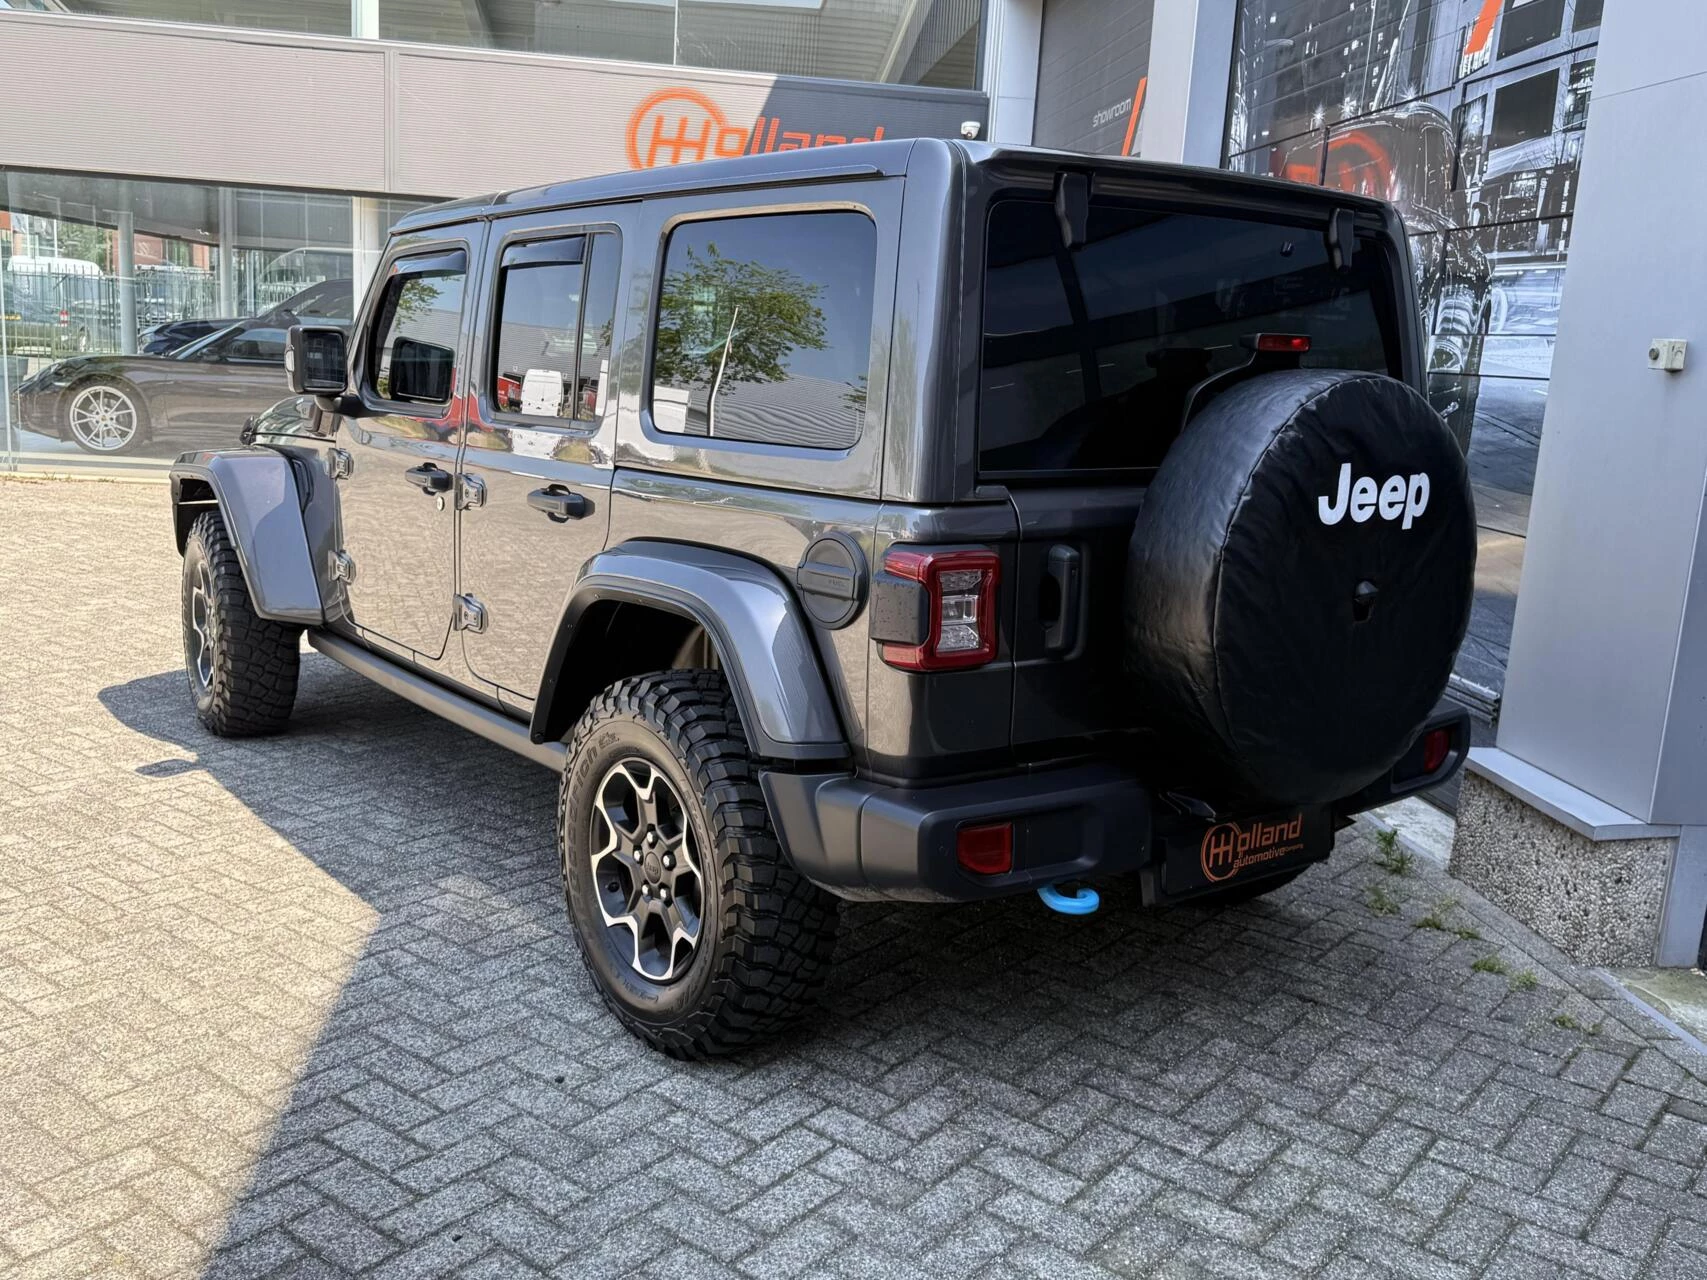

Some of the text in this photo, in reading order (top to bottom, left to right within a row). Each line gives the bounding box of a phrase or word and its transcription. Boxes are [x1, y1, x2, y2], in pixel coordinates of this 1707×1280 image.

[1092, 98, 1132, 128] showroom
[1318, 463, 1430, 530] Jeep
[1206, 812, 1303, 870] Holland
[1233, 846, 1285, 868] automotive
